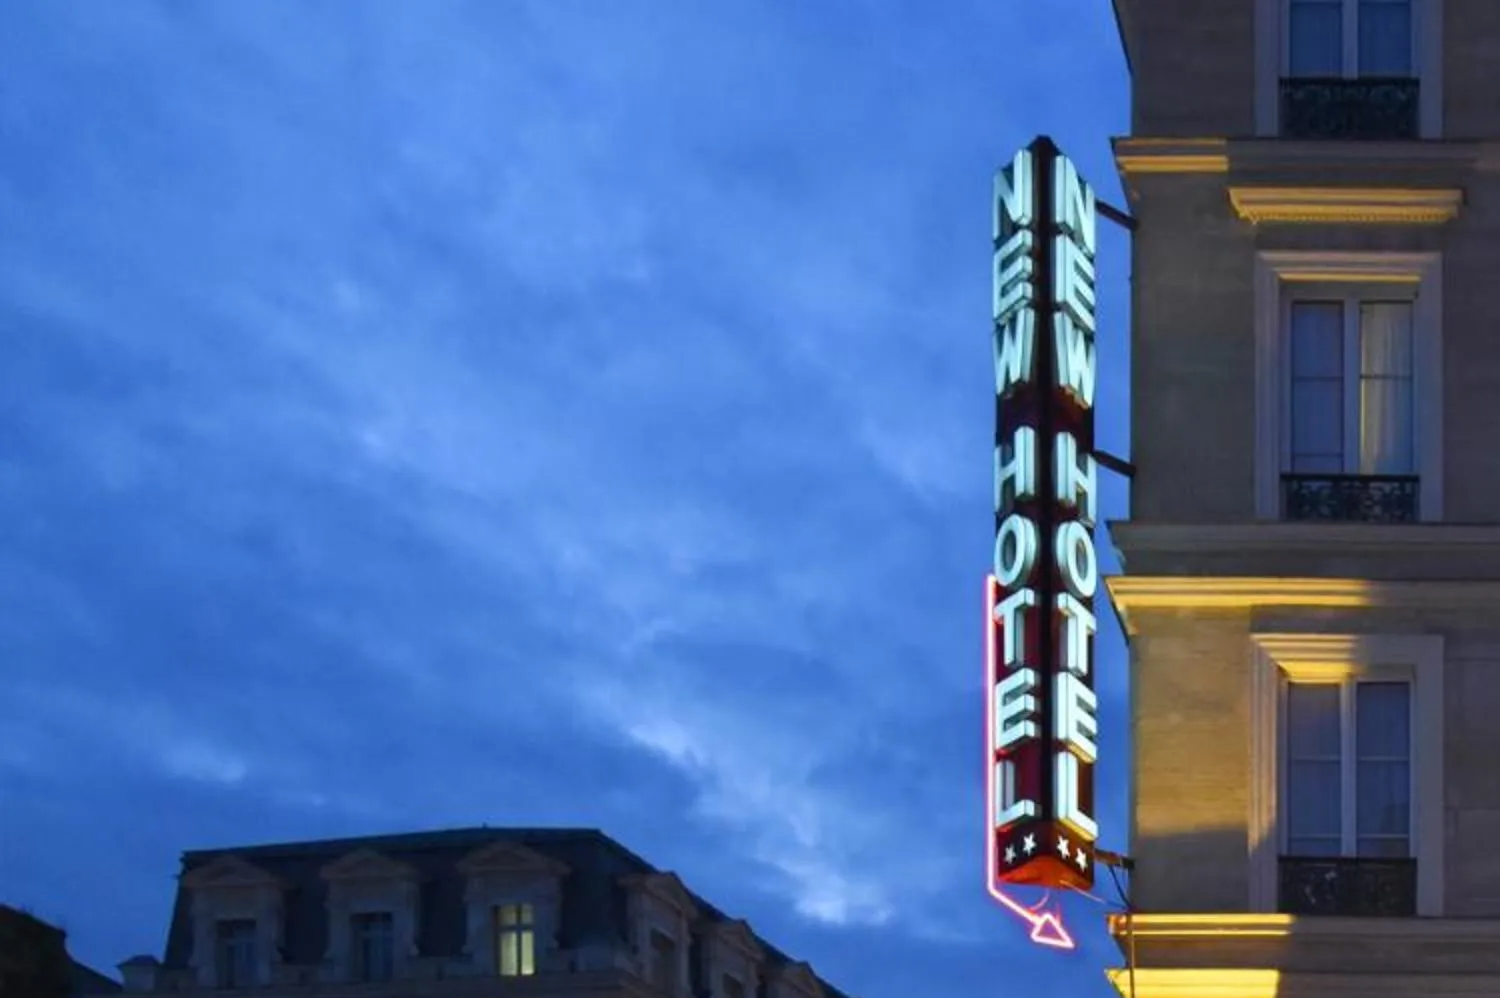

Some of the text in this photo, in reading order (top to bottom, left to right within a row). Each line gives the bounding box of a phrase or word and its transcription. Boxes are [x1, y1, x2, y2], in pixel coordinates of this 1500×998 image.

[992, 147, 1037, 835] NEW HOTEL
[1052, 154, 1099, 843] NEW HOTEL
